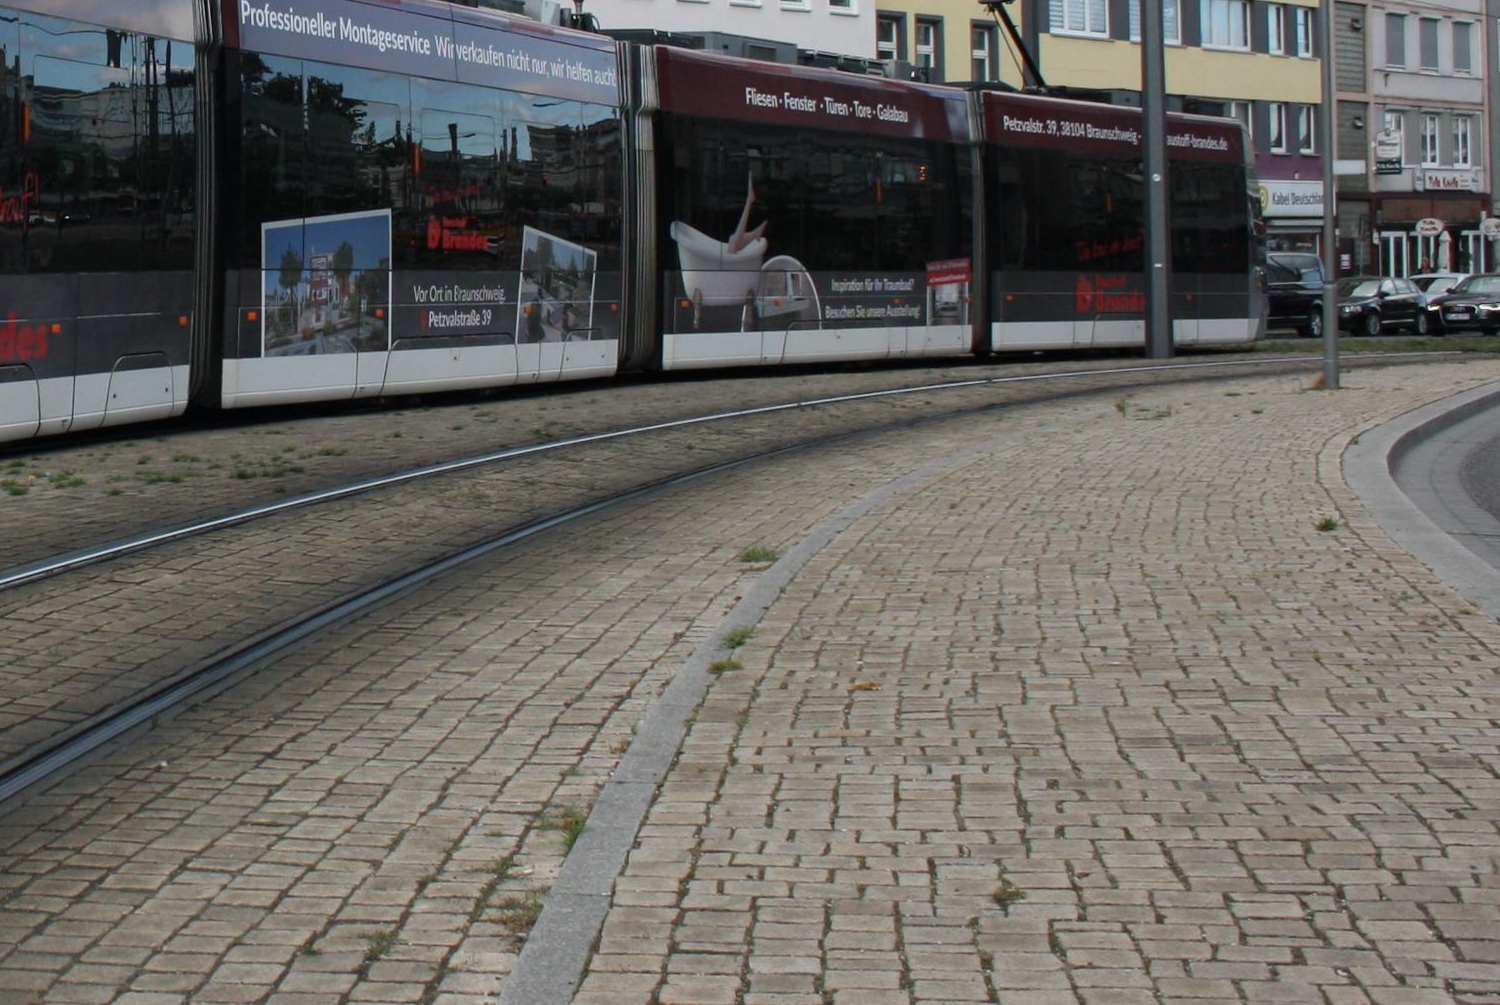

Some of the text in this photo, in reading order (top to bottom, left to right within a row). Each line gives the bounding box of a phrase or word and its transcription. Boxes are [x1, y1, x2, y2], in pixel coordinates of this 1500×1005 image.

[240, 0, 337, 39] Professioneller
[339, 16, 431, 55] Montageservice
[434, 34, 455, 59] Wir
[455, 41, 505, 68] verkaufen
[506, 49, 530, 72] nicht
[531, 58, 549, 77] nur,
[550, 58, 566, 77] wir
[565, 60, 593, 83] helfen
[745, 87, 909, 123] Fliesen Fenster Türen Tore Galabau
[1003, 115, 1045, 135] Petzvalstr.
[1060, 121, 1086, 138] 38104
[1086, 124, 1138, 145] Braunschweig
[1166, 133, 1229, 151] austoff-brandes.de
[413, 285, 428, 302] Vor
[429, 285, 444, 302] Ort
[444, 285, 453, 301] in
[428, 309, 492, 328] Petzvalstraße 39
